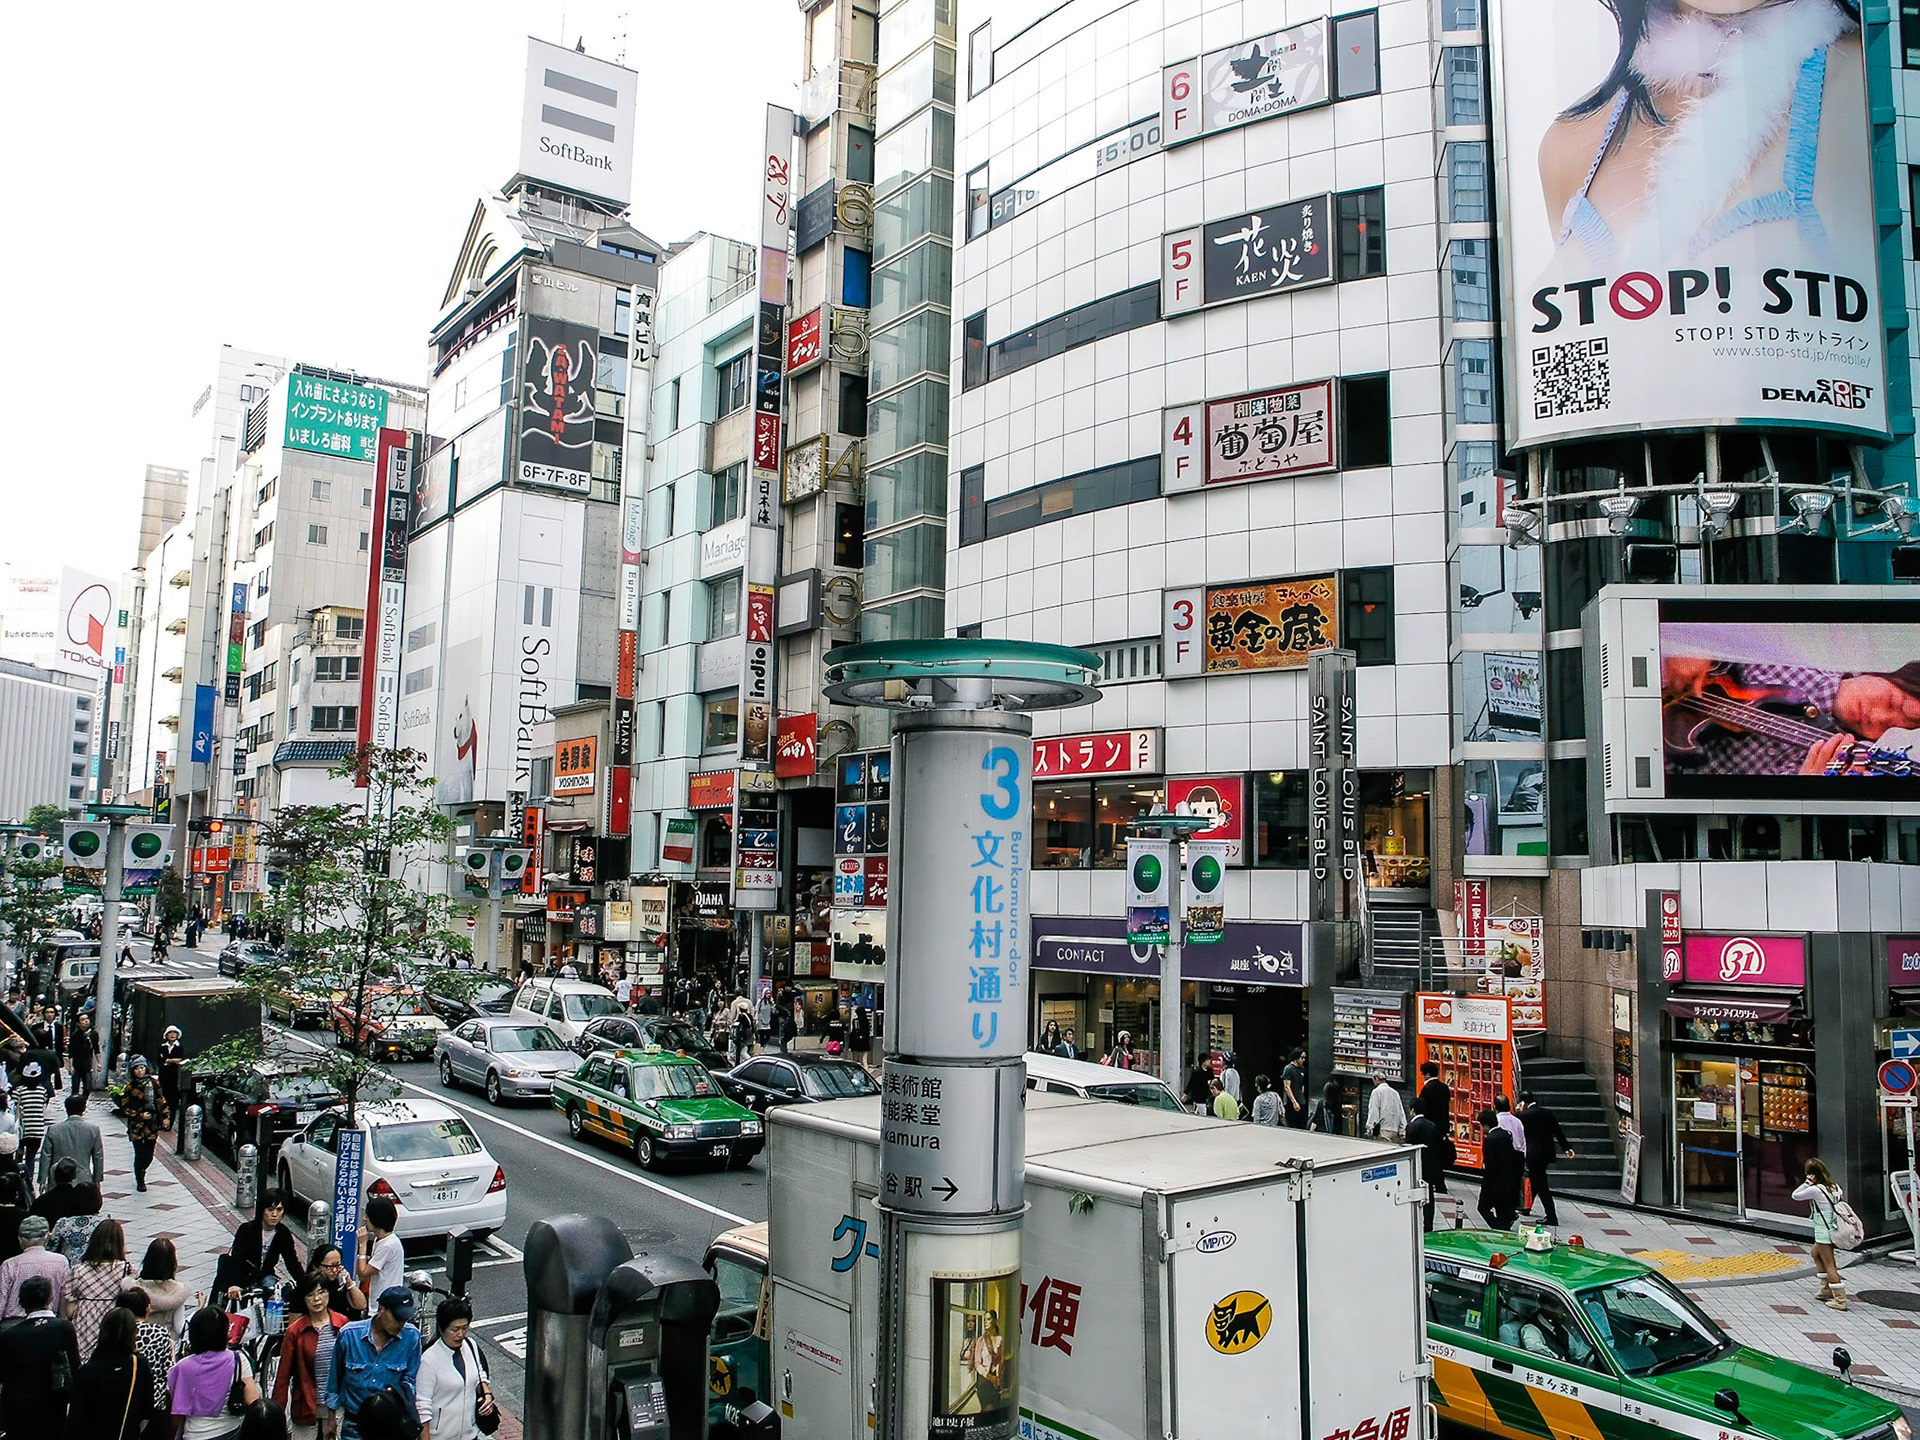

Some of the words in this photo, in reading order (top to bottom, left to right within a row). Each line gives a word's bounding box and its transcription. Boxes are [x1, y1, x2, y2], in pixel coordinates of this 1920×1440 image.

[1228, 96, 1298, 122] DOMA-DOMA
[539, 136, 614, 173] SoftBank
[1213, 215, 1304, 287] 花火
[1236, 270, 1267, 286] KAEN
[1532, 266, 1732, 334] STOP!
[1762, 267, 1869, 323] STD
[1674, 326, 1734, 343] STOP!
[1745, 327, 1779, 341] STD
[1785, 328, 1871, 352] ホットライン
[1713, 346, 1871, 369] www.stop-std.jp/mobile/
[1761, 387, 1867, 410] DEMAND
[1816, 379, 1874, 400] SOFT
[291, 401, 379, 432] インプラントあります
[289, 427, 352, 452] いましろ歯科
[1214, 410, 1324, 461] 葡萄屋
[1238, 453, 1299, 474] ぶどうや
[757, 481, 771, 524] 日本海
[626, 571, 637, 625] Euphoria
[5, 630, 54, 638] Bunkamura
[382, 607, 398, 664] SoftBank
[1208, 602, 1328, 653] 黄金の蔵
[60, 649, 112, 670] TOKYU
[377, 696, 393, 747] SoftBan
[403, 707, 431, 731] SoftBank
[515, 635, 551, 783] SoftBank
[1313, 696, 1325, 759] SAINT
[1341, 695, 1352, 757] SAINT
[559, 743, 592, 772] 吉野家
[1035, 738, 1122, 773] ストラン
[558, 776, 591, 788] YOSHINOYA
[980, 746, 1020, 821] 3
[1313, 768, 1326, 830] LOUIS
[1342, 768, 1354, 831] LOUIS
[1314, 839, 1326, 880] BLD
[1343, 839, 1354, 881] BLD
[745, 874, 774, 885] 日本海
[695, 891, 724, 907] DIANA
[1009, 831, 1022, 987] Bunkamura-dori
[968, 830, 1005, 1050] 文化村通り
[1057, 948, 1105, 963] CONTACT
[1723, 1008, 1758, 1019] アイスクリーム
[881, 1172, 923, 1198] 谷駅
[1434, 1344, 1455, 1358] 1597
[1525, 1371, 1544, 1387] 杉並
[1559, 1383, 1579, 1397] 交通
[1624, 1403, 1642, 1416] 杉並
